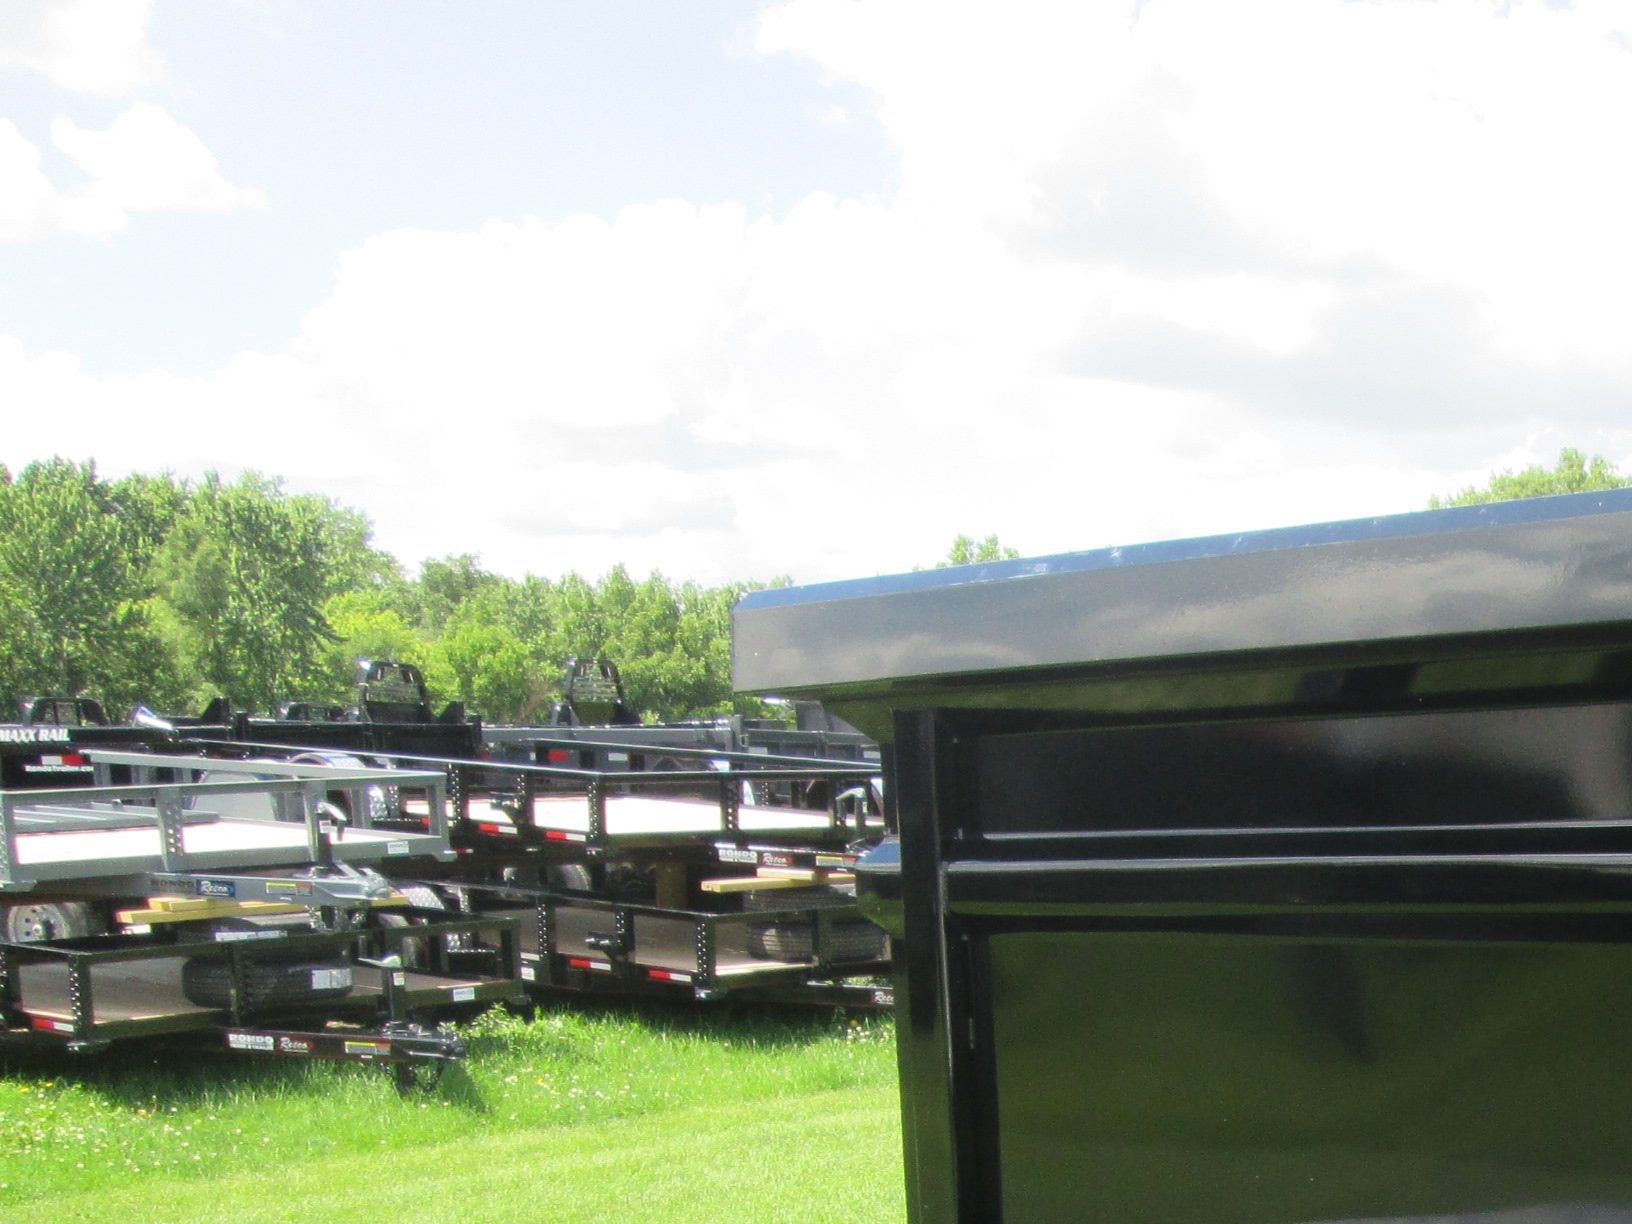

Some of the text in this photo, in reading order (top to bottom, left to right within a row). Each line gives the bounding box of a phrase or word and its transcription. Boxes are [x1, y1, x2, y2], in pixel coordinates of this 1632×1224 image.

[38, 729, 70, 741] RAIL
[719, 848, 758, 858] RONDO
[228, 1034, 275, 1045] RONDO
